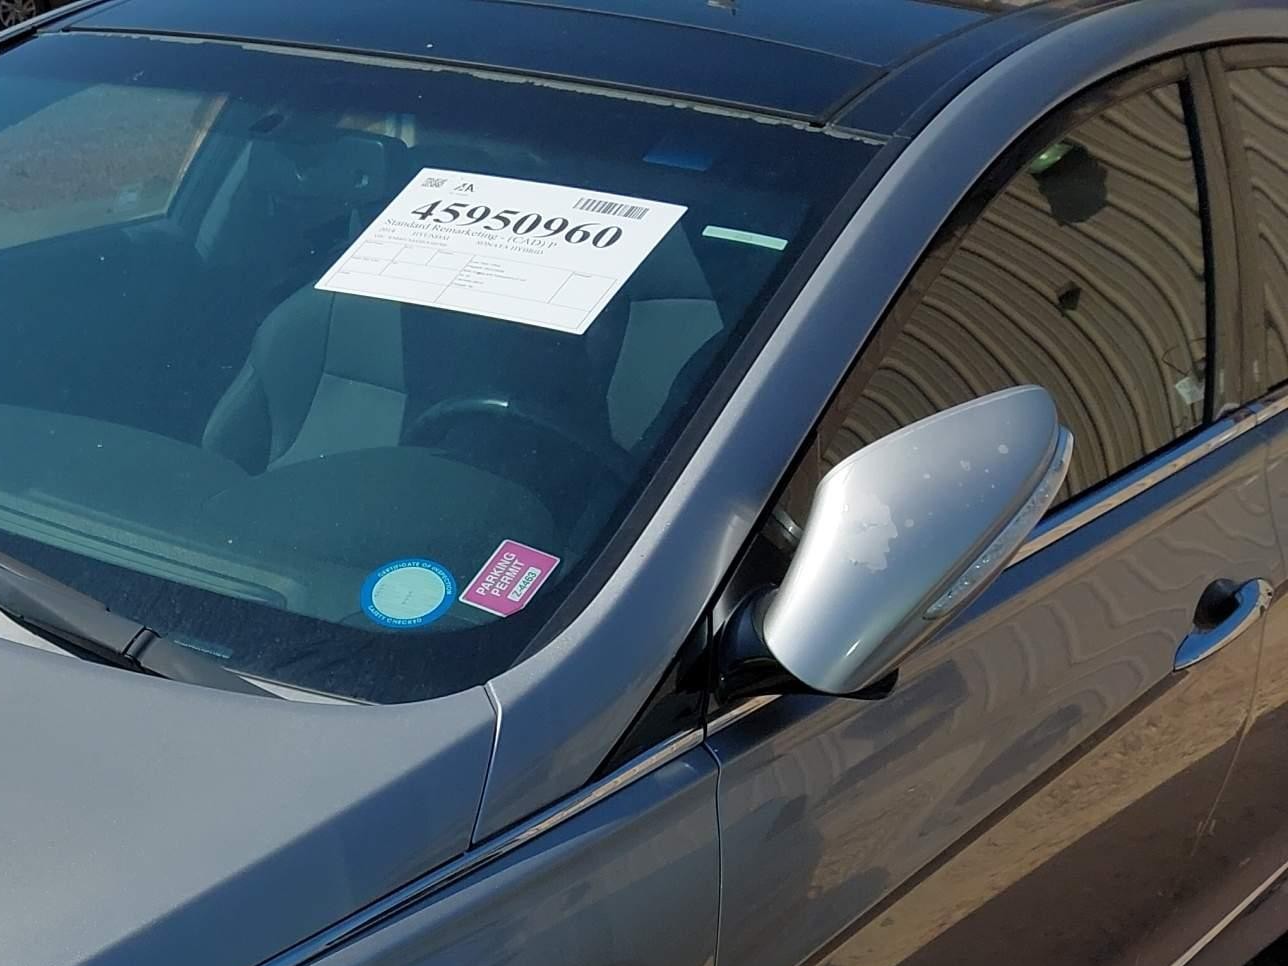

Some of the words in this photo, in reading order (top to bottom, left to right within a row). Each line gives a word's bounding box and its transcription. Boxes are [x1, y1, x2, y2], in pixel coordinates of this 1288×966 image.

[384, 217, 431, 232] Standard
[431, 220, 500, 241] Remarketing
[411, 199, 623, 249] 45950960
[412, 230, 451, 241] HYUNDAI
[510, 245, 545, 255] HYBRID
[475, 551, 517, 596] PARKING
[491, 558, 525, 597] PERMIT
